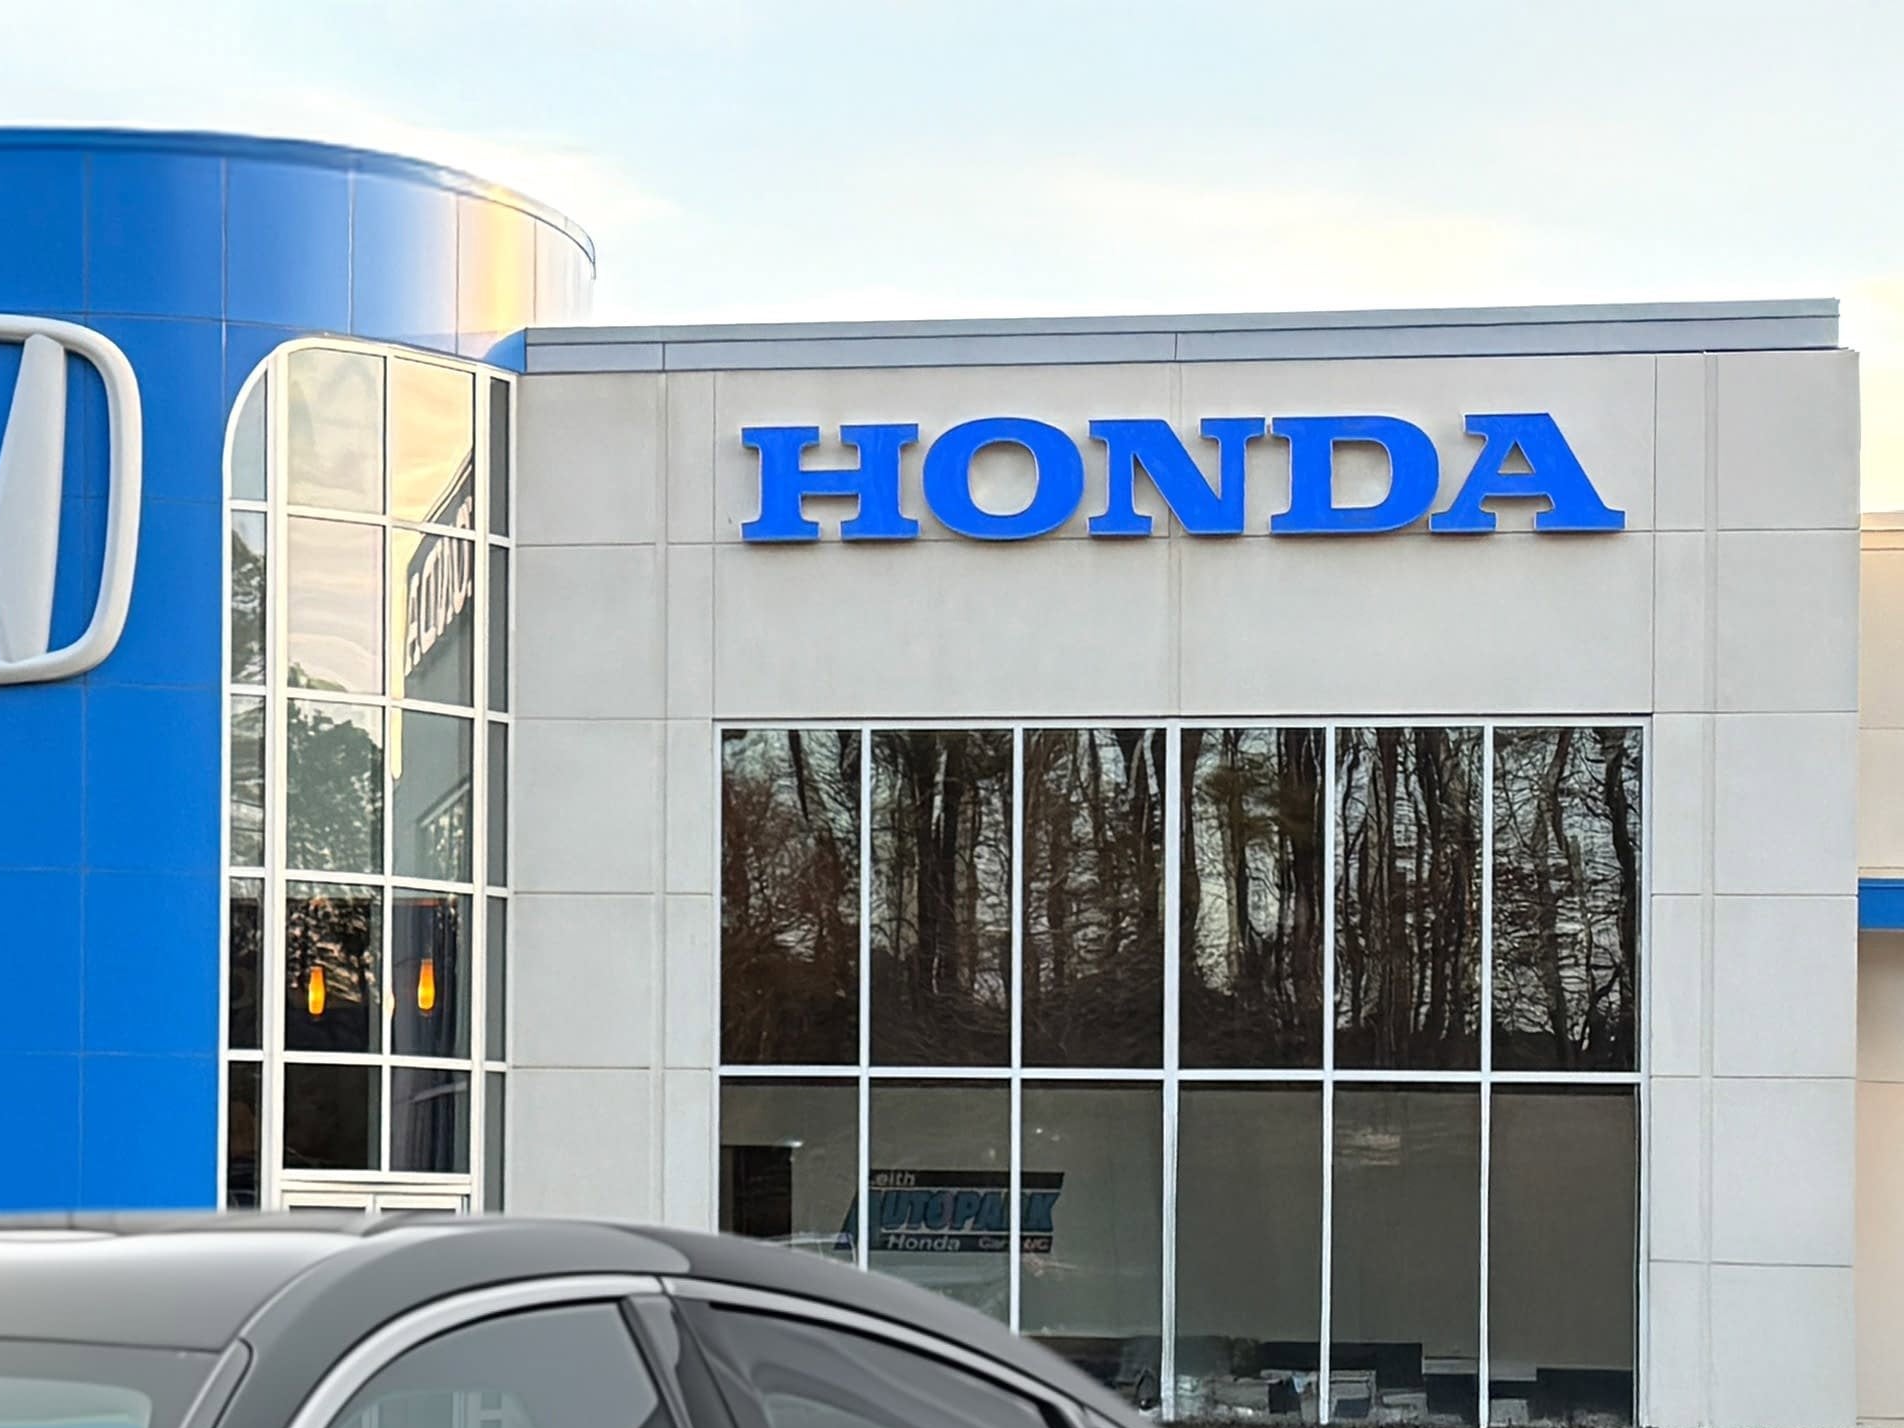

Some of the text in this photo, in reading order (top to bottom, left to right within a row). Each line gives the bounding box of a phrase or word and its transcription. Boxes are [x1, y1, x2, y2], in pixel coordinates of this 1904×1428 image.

[740, 412, 1627, 542] HONDA
[871, 1171, 916, 1187] eith
[886, 1235, 961, 1252] Honda
[978, 1236, 1010, 1250] Car
